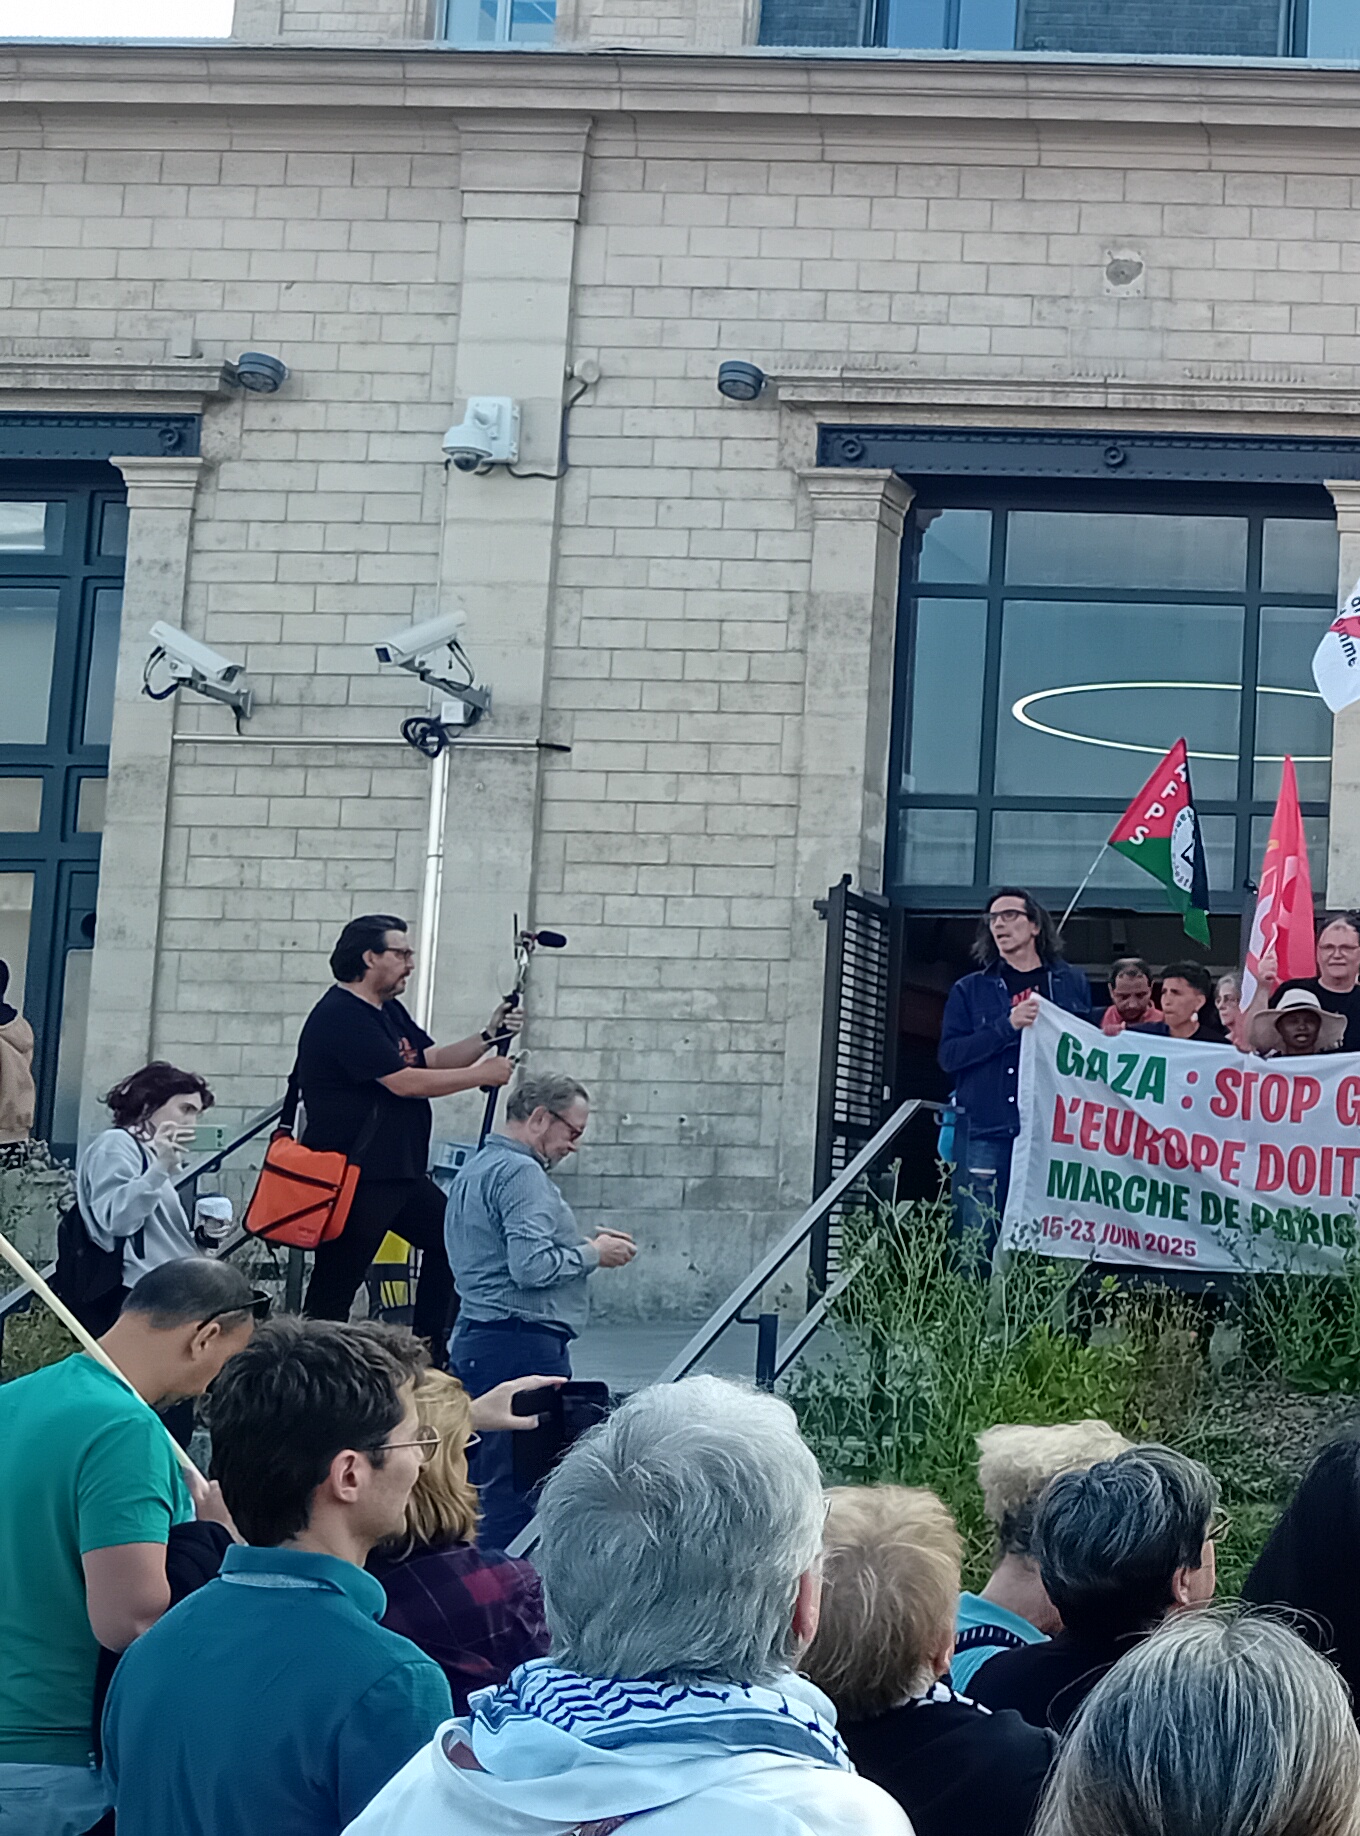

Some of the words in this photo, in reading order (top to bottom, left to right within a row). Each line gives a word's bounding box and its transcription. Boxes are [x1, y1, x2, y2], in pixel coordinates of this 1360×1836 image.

[1056, 1031, 1167, 1104] GAZA
[1209, 1068, 1321, 1124] STOP
[1047, 1159, 1190, 1222] MARCHE
[1200, 1191, 1241, 1230] DE
[1250, 1202, 1358, 1249] PARIS
[1098, 1223, 1141, 1250] JUIN
[1144, 1232, 1197, 1257] 2025
